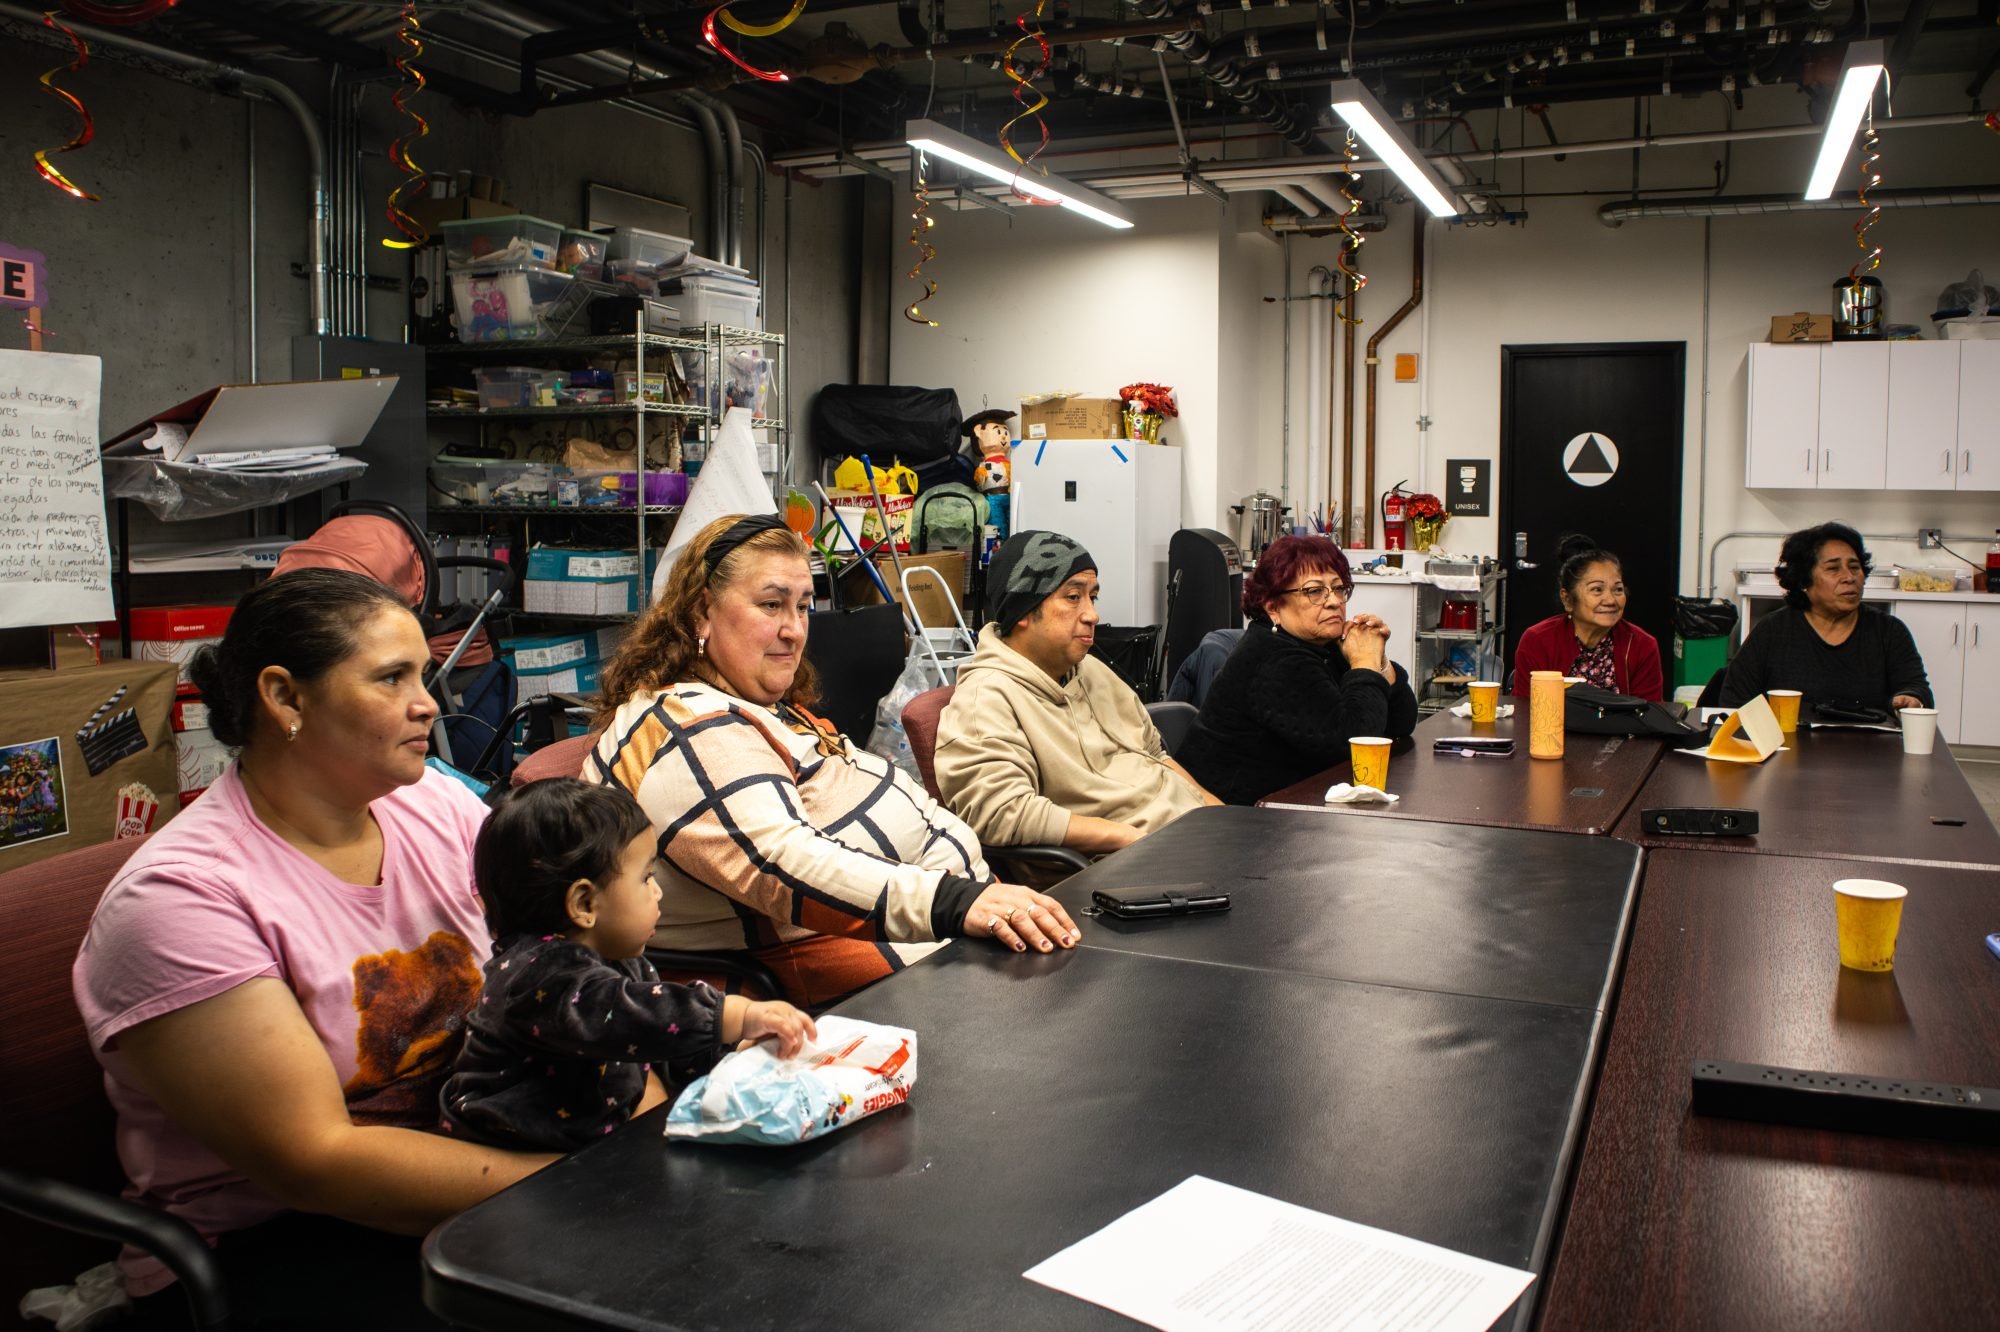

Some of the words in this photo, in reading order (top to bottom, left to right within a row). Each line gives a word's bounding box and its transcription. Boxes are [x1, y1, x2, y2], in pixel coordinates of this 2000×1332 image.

[4, 260, 26, 298] E
[31, 425, 46, 439] las
[53, 429, 92, 445] familias
[10, 458, 20, 470] el
[125, 819, 143, 829] POP
